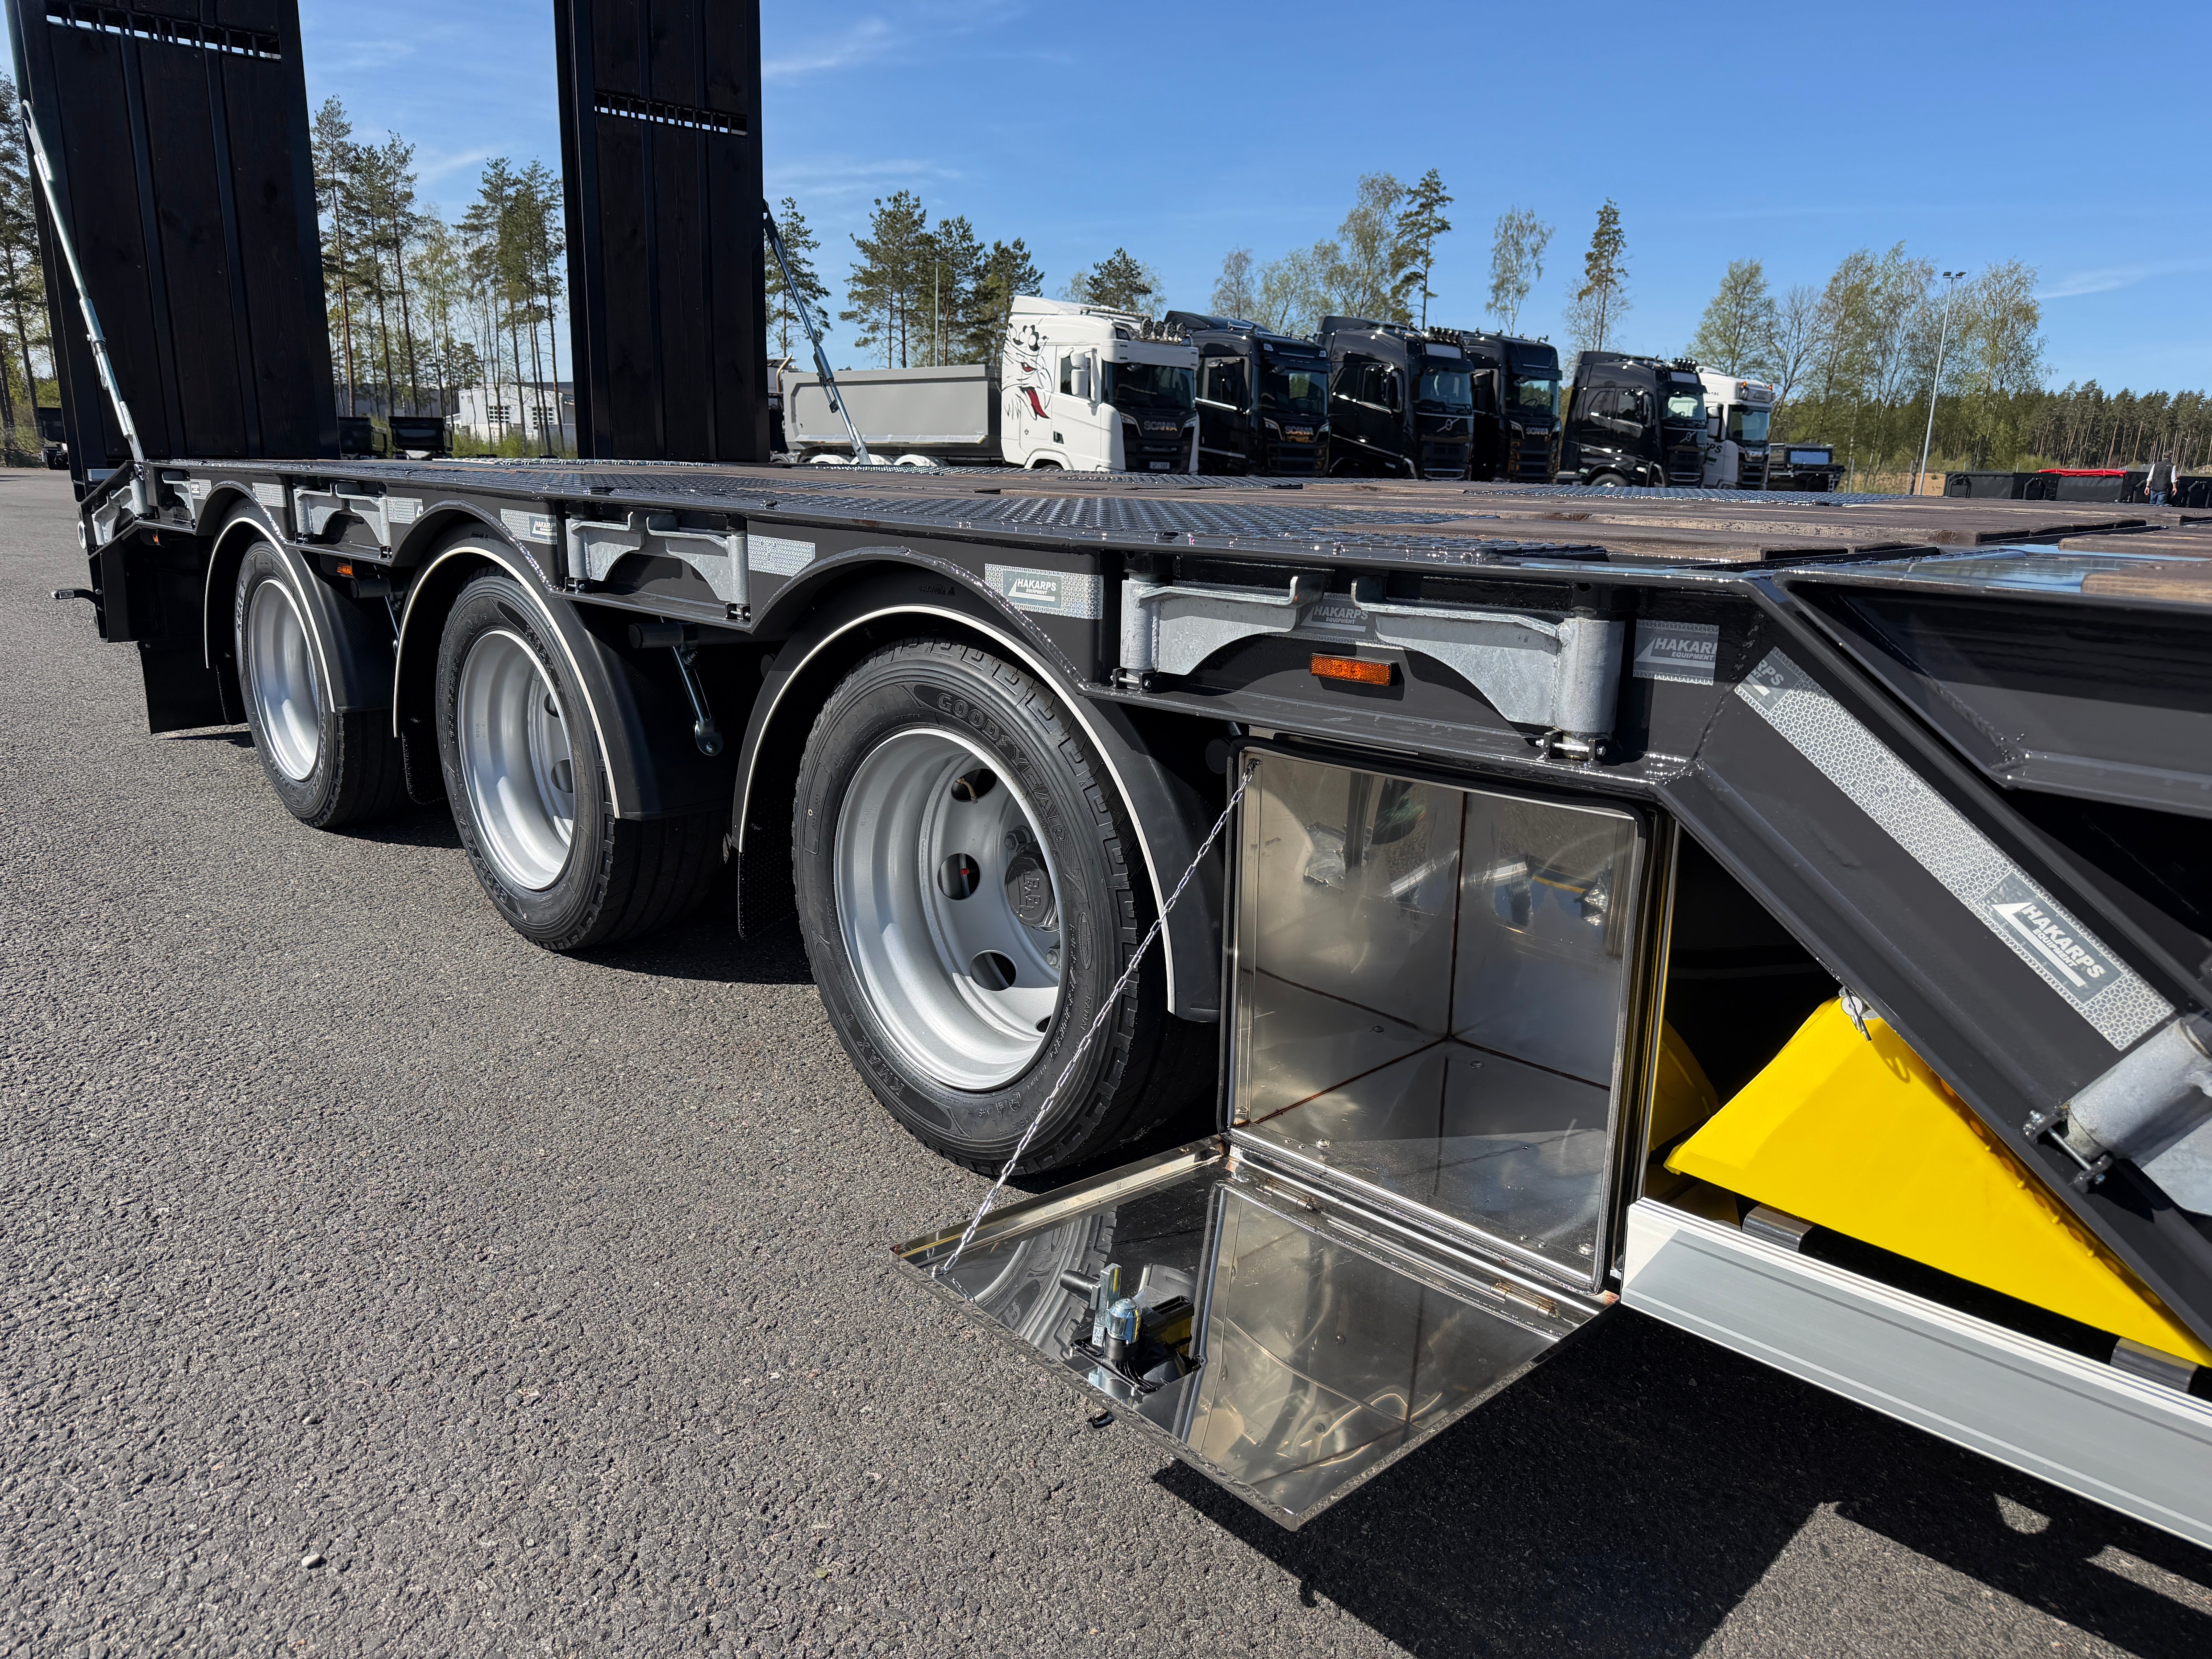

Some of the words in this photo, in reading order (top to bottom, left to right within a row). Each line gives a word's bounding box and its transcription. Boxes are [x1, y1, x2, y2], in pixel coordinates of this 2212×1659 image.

[1143, 420, 1178, 431] SCANIA
[1017, 578, 1057, 592] HAKARPS
[1314, 605, 1369, 620] HAKARPS
[1325, 617, 1356, 625] EQUIPMENT
[1671, 651, 1714, 661] EQUIPMENT
[936, 692, 1066, 843] GOODYEAR
[2021, 905, 2106, 978] HAKARPS
[2032, 929, 2077, 967] EQUIPMENT
[1079, 994, 1092, 1032] RADIAL
[856, 1035, 905, 1097] KMAX
